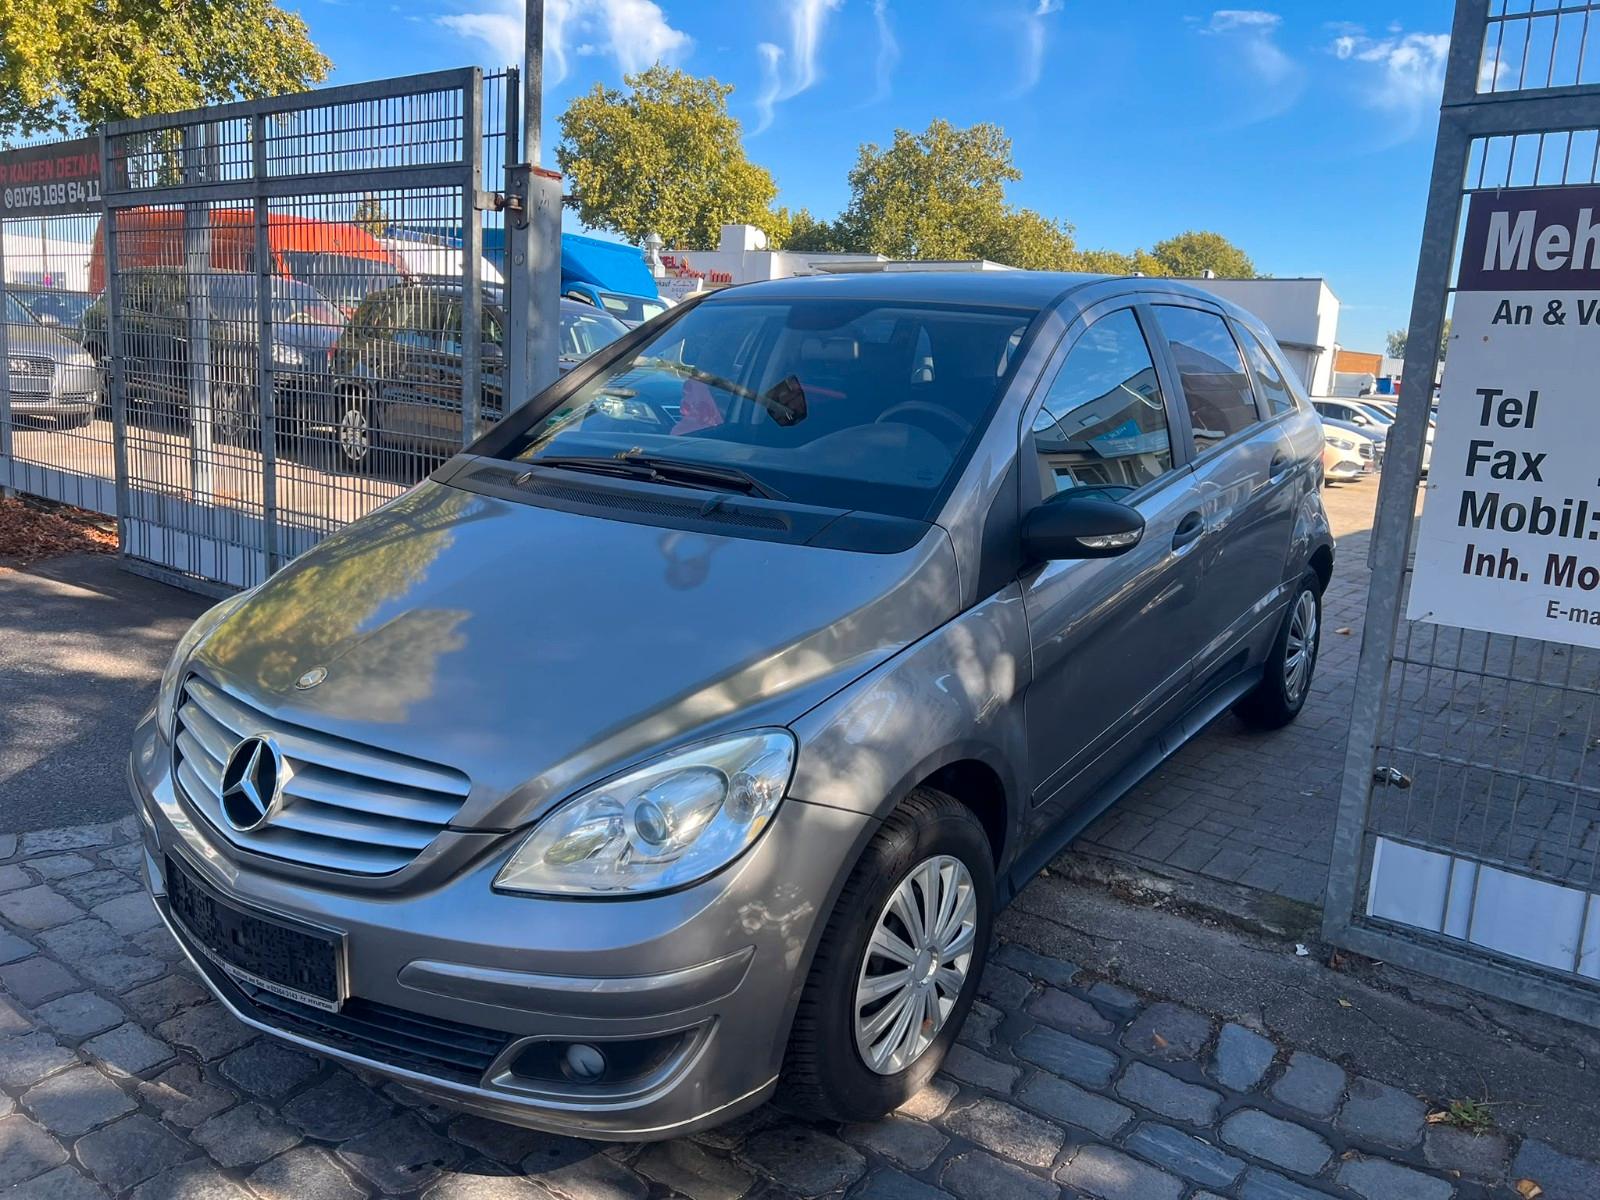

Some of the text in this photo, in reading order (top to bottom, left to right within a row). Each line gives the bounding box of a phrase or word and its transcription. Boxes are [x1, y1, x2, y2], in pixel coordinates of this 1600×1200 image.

[10, 159, 54, 182] KAUFEN
[14, 185, 41, 208] 0179
[1482, 207, 1600, 271] Meh
[1491, 299, 1600, 326] An & V
[1475, 388, 1539, 429] Tel
[1465, 439, 1548, 482] Fax
[1457, 490, 1600, 540] Mobil:
[1462, 543, 1600, 591] Inh. Mo
